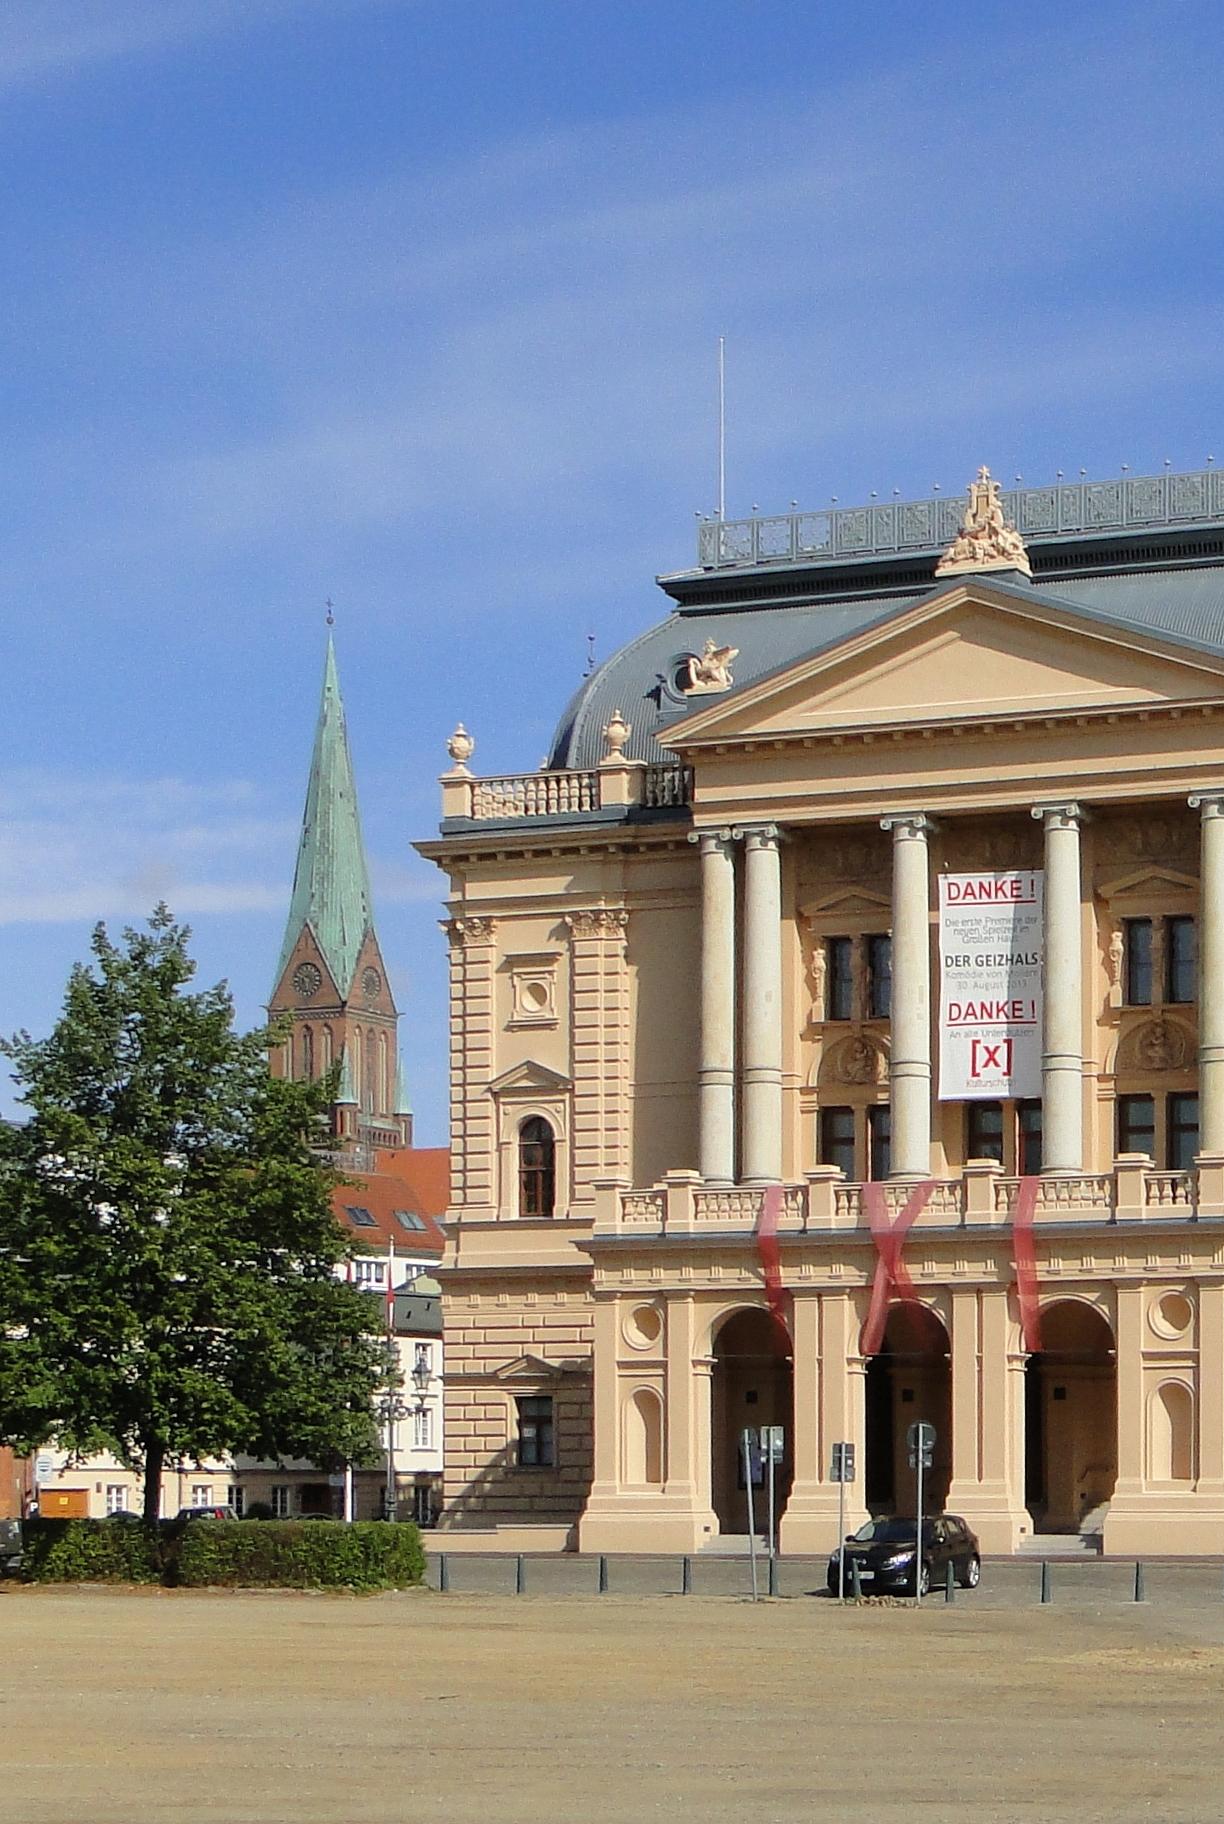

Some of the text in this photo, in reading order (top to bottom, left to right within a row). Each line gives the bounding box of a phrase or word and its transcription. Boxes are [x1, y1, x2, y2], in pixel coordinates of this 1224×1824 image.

[947, 880, 1022, 900] DANKE
[945, 952, 1038, 967] DER GEIZHALS
[949, 1000, 1024, 1021] DANKE
